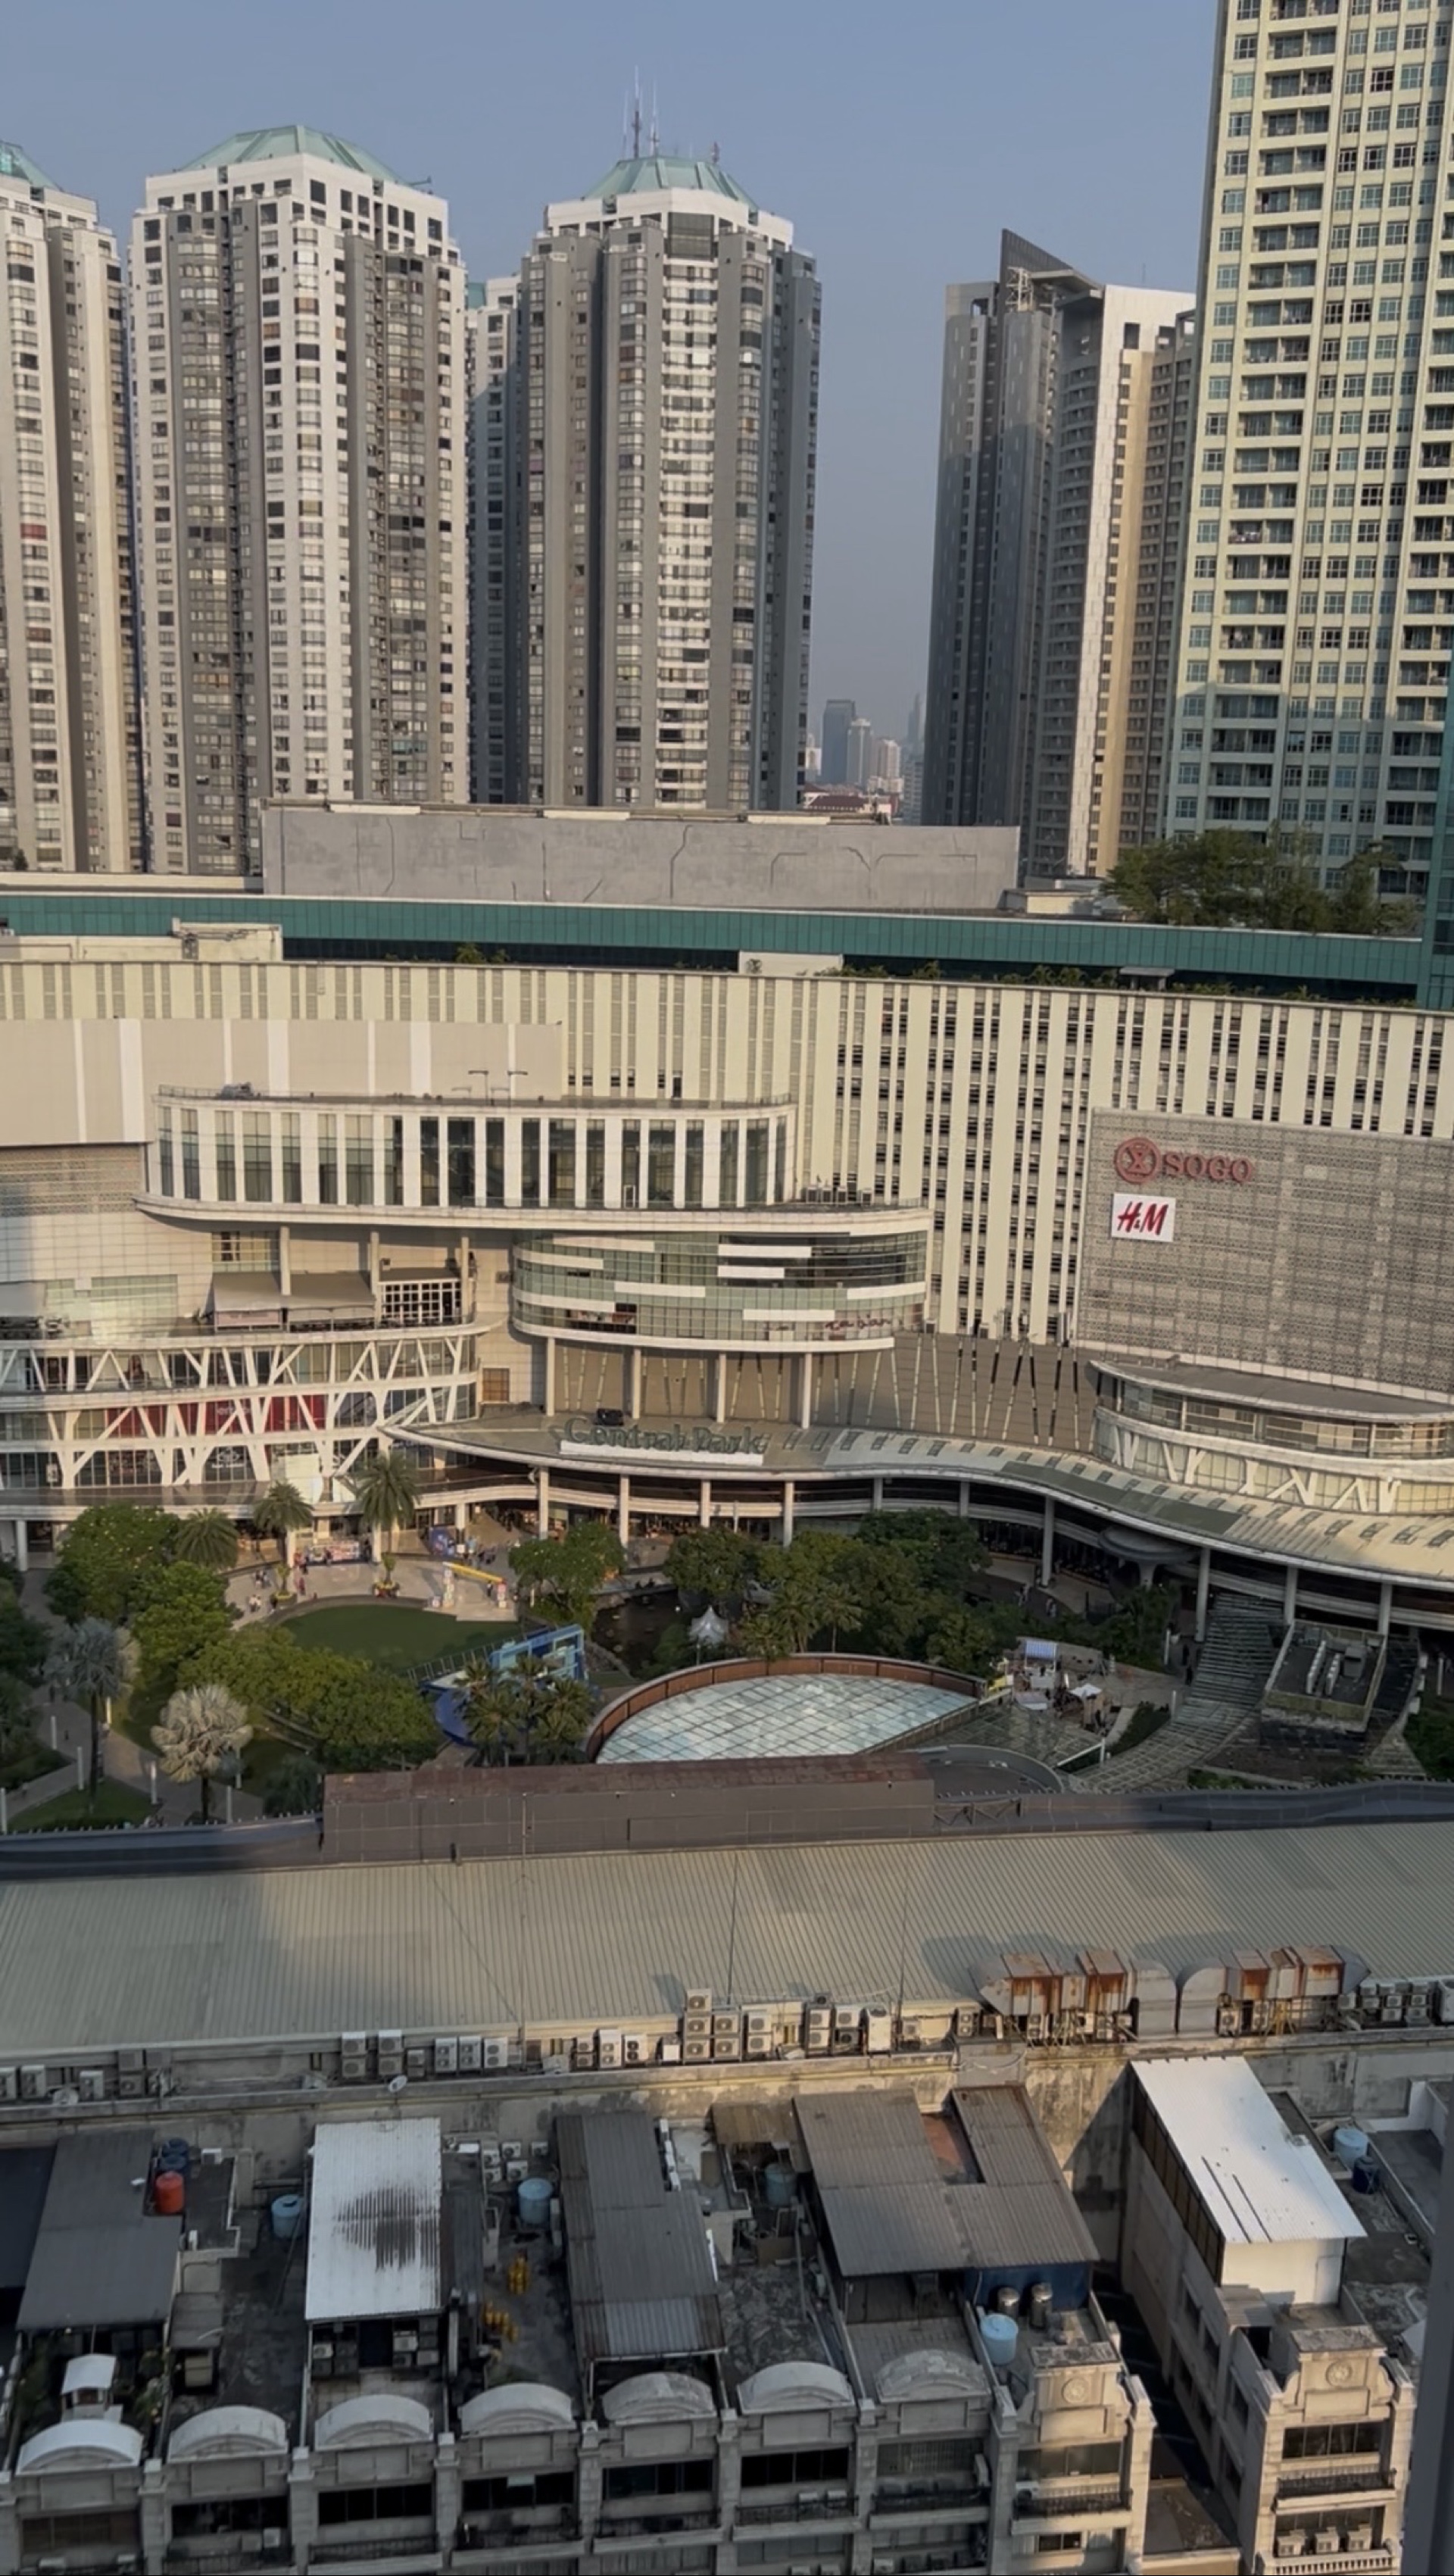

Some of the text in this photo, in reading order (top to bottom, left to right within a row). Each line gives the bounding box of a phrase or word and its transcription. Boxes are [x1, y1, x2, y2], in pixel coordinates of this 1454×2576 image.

[1162, 1151, 1254, 1183] SOGO
[1117, 1201, 1169, 1236] H&M
[563, 1416, 769, 1454] Central Park
